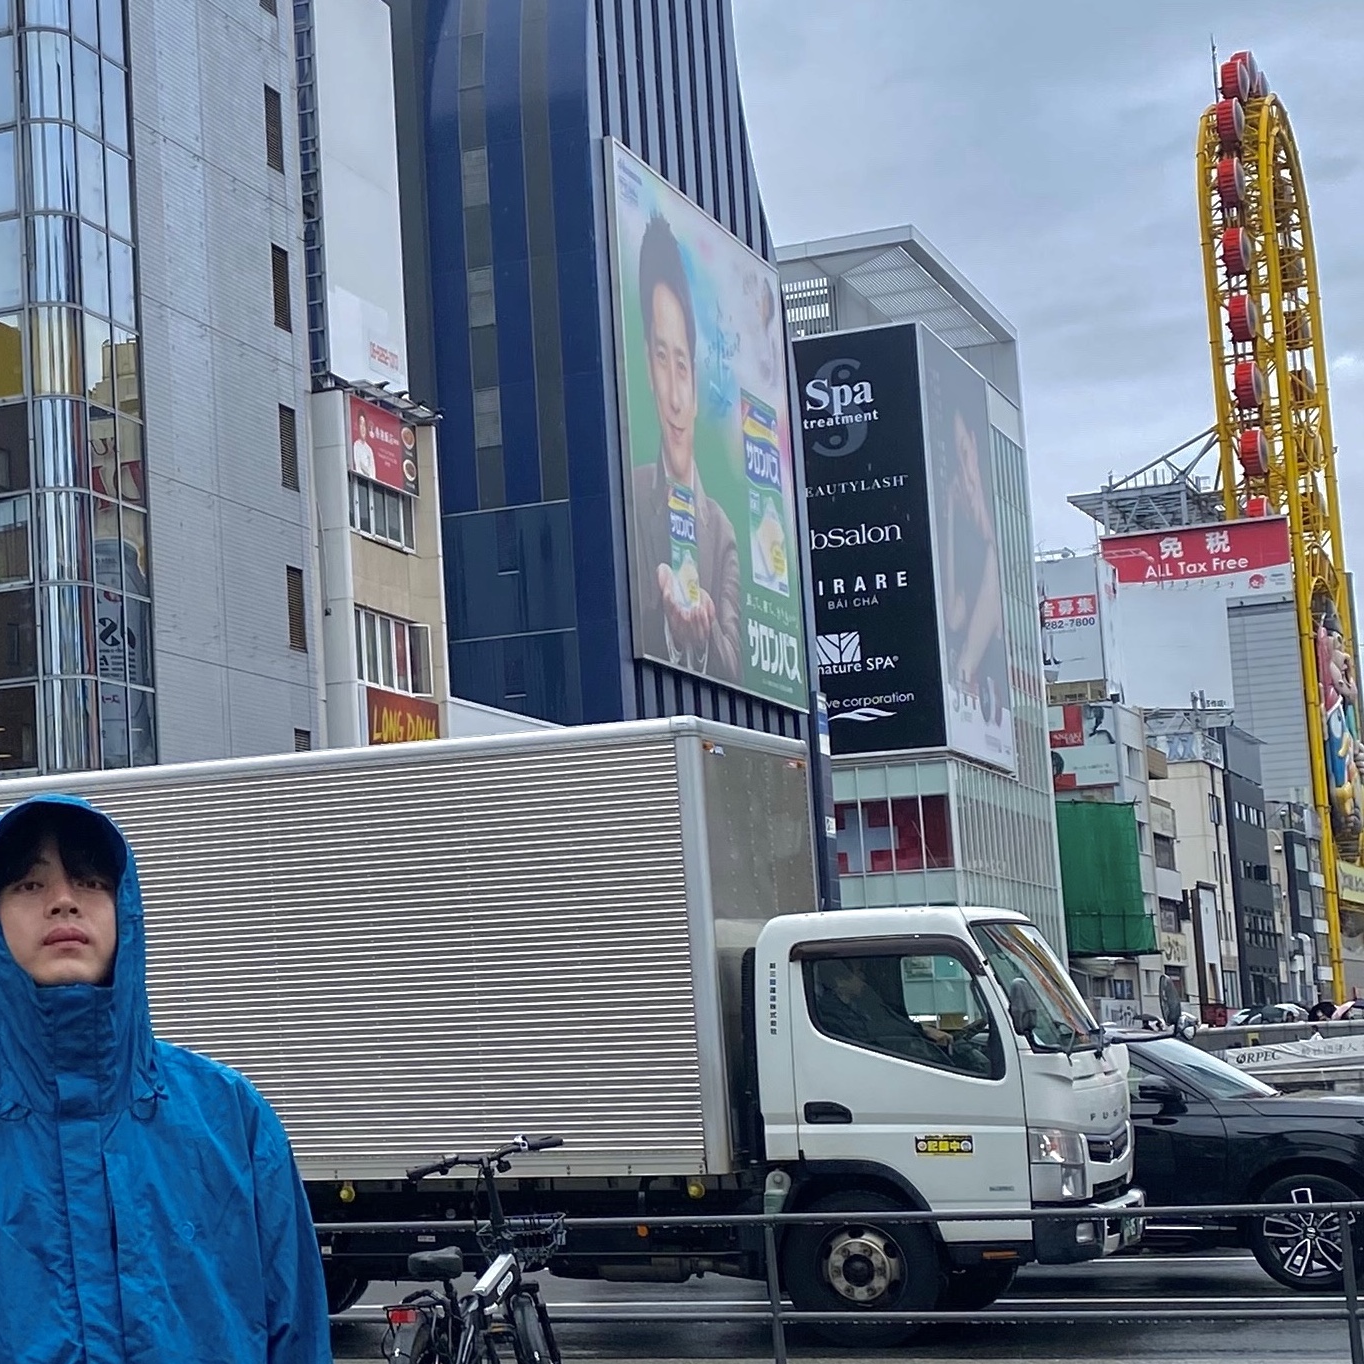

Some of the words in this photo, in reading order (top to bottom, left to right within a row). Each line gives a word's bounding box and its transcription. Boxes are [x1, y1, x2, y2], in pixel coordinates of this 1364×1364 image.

[805, 378, 875, 417] Spa
[802, 409, 879, 430] treatment
[1145, 564, 1174, 579] ALL
[1178, 561, 1207, 575] Tax
[1212, 557, 1250, 571] Free
[747, 617, 803, 685] サロンパス
[842, 691, 915, 710] corporation
[373, 704, 405, 743] LONG
